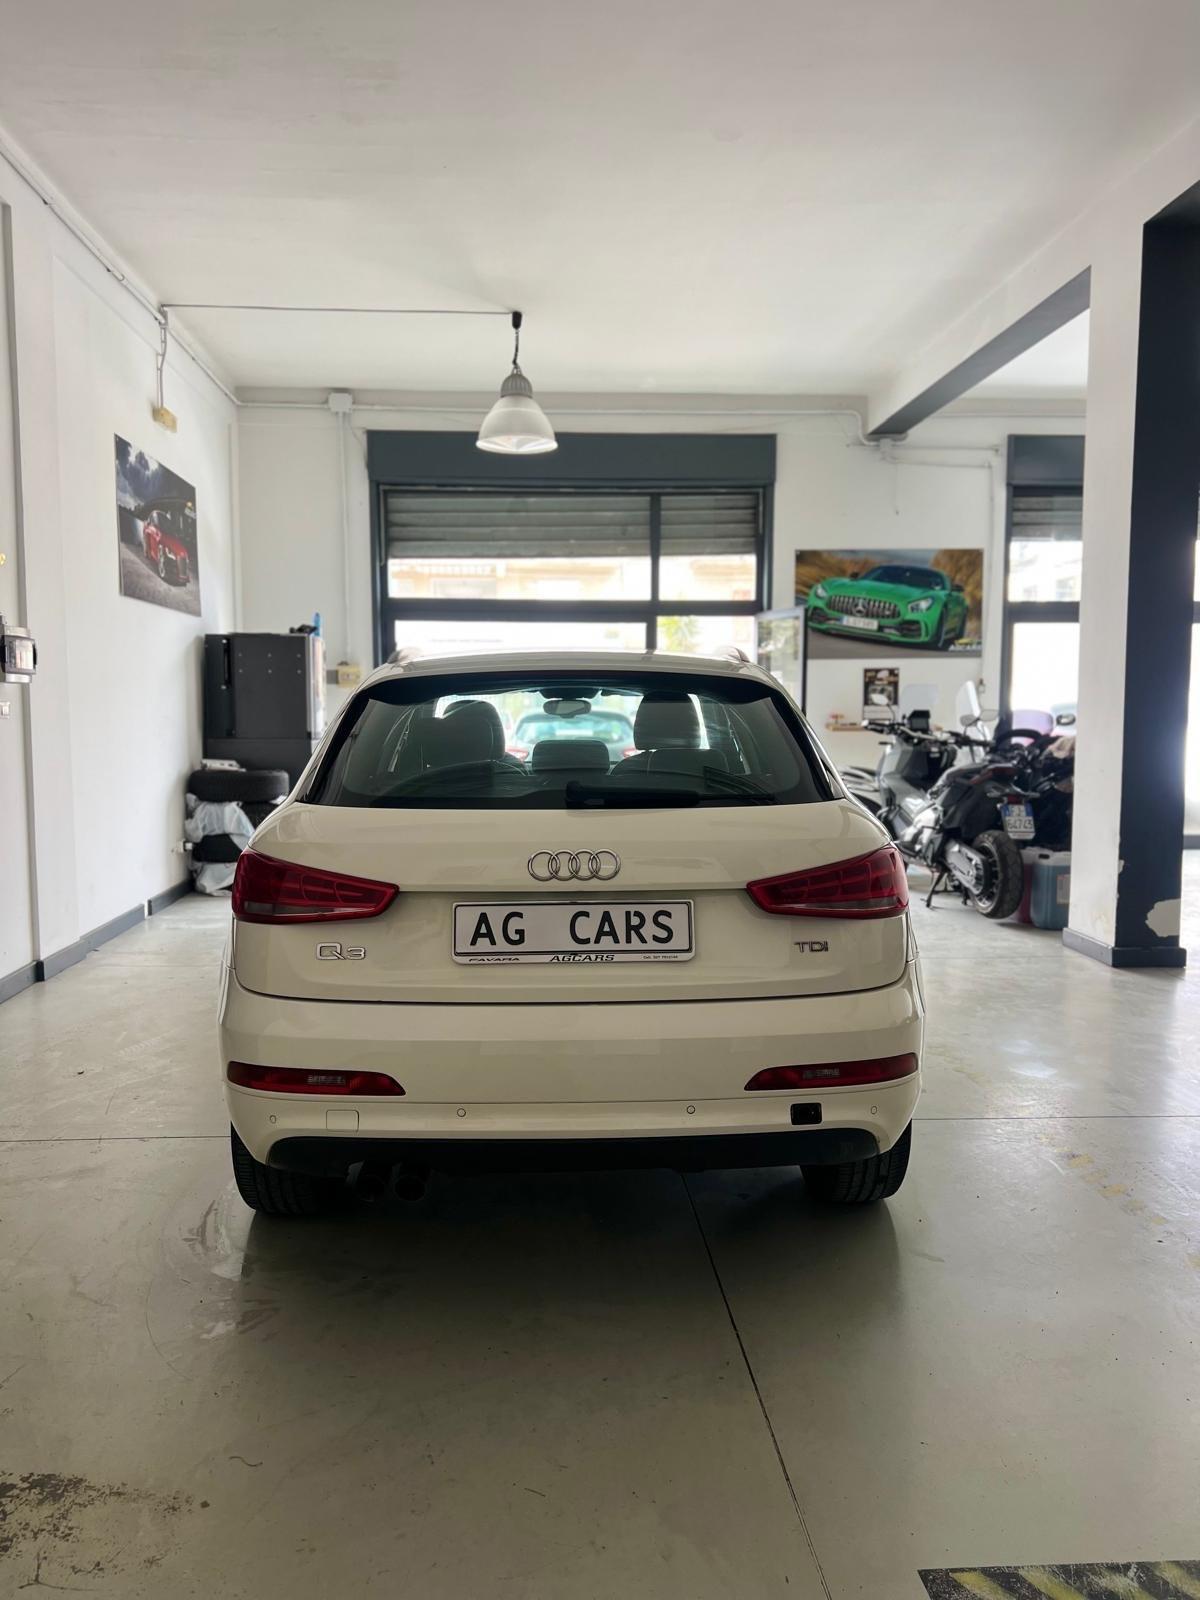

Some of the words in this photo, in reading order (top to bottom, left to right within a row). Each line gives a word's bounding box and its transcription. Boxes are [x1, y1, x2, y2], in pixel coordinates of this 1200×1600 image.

[470, 911, 525, 946] AG
[569, 910, 674, 945] CARS
[316, 942, 366, 960] Q3
[794, 940, 828, 953] TDI
[550, 954, 615, 962] AGCARS
